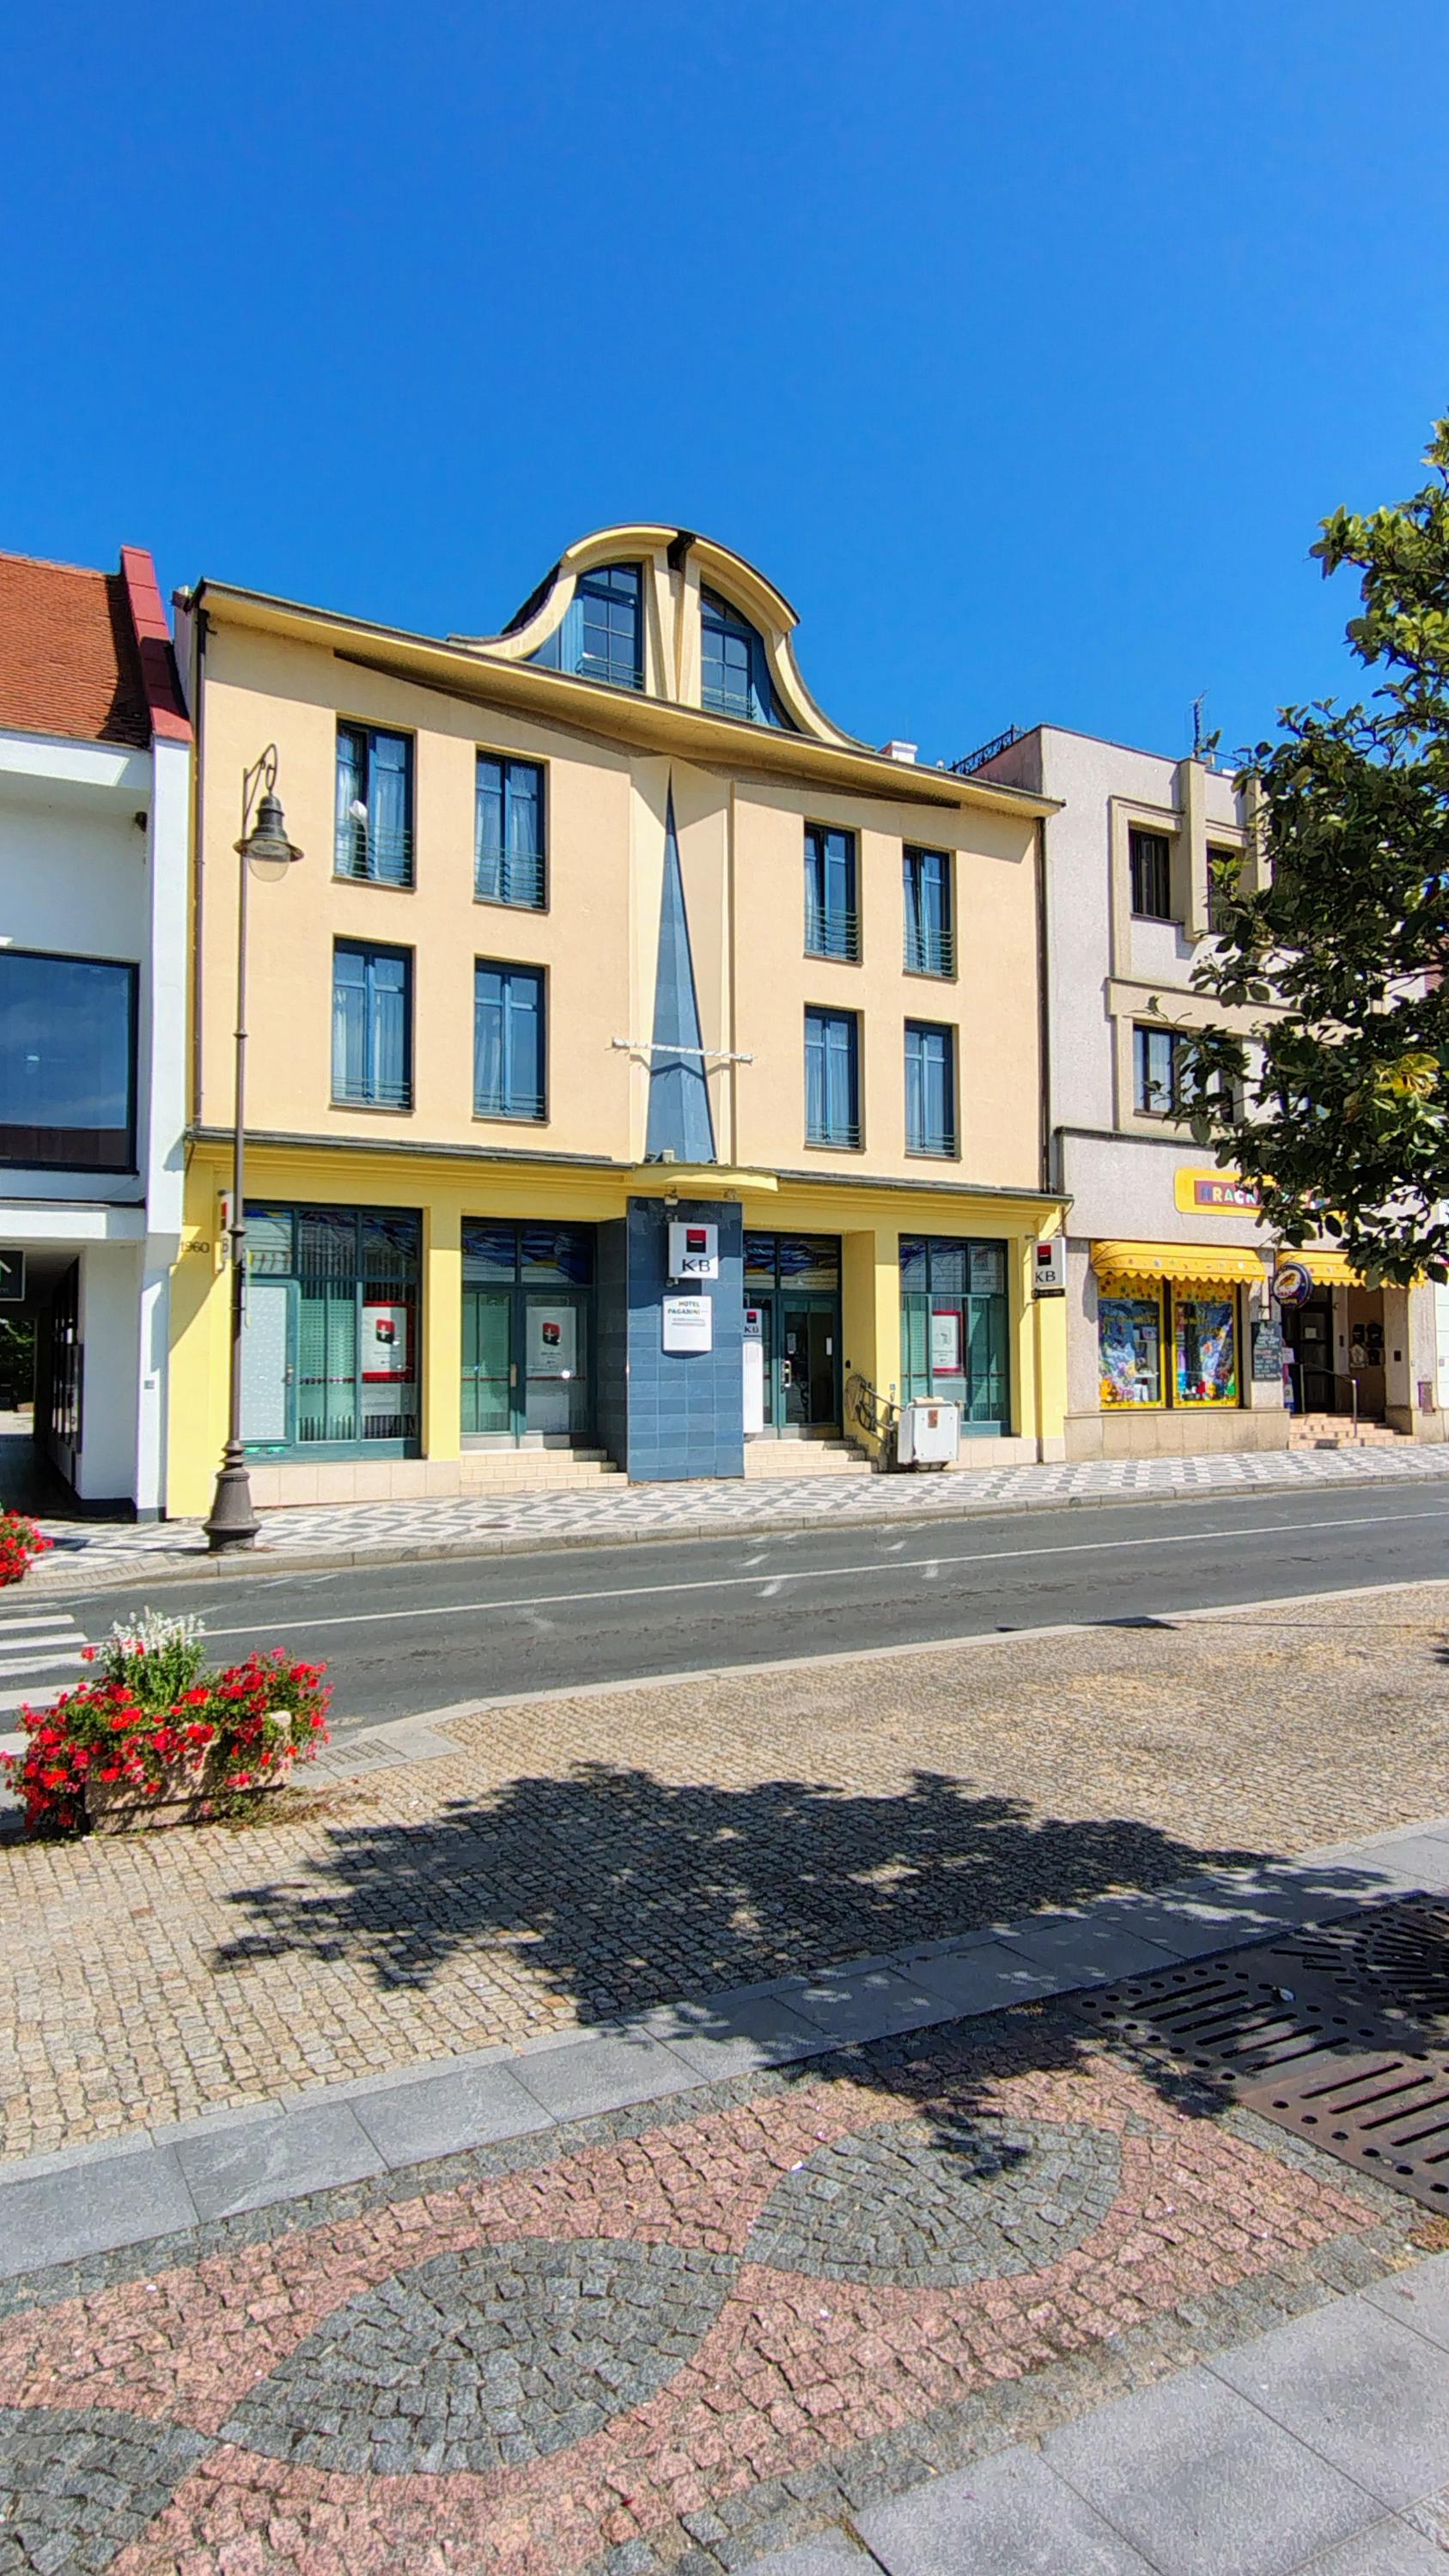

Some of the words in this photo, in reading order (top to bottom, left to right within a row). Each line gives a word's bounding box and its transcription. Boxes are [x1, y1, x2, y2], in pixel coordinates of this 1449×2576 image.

[181, 1240, 210, 1254] 1960
[682, 1259, 710, 1273] KB
[1035, 1271, 1056, 1283] KB
